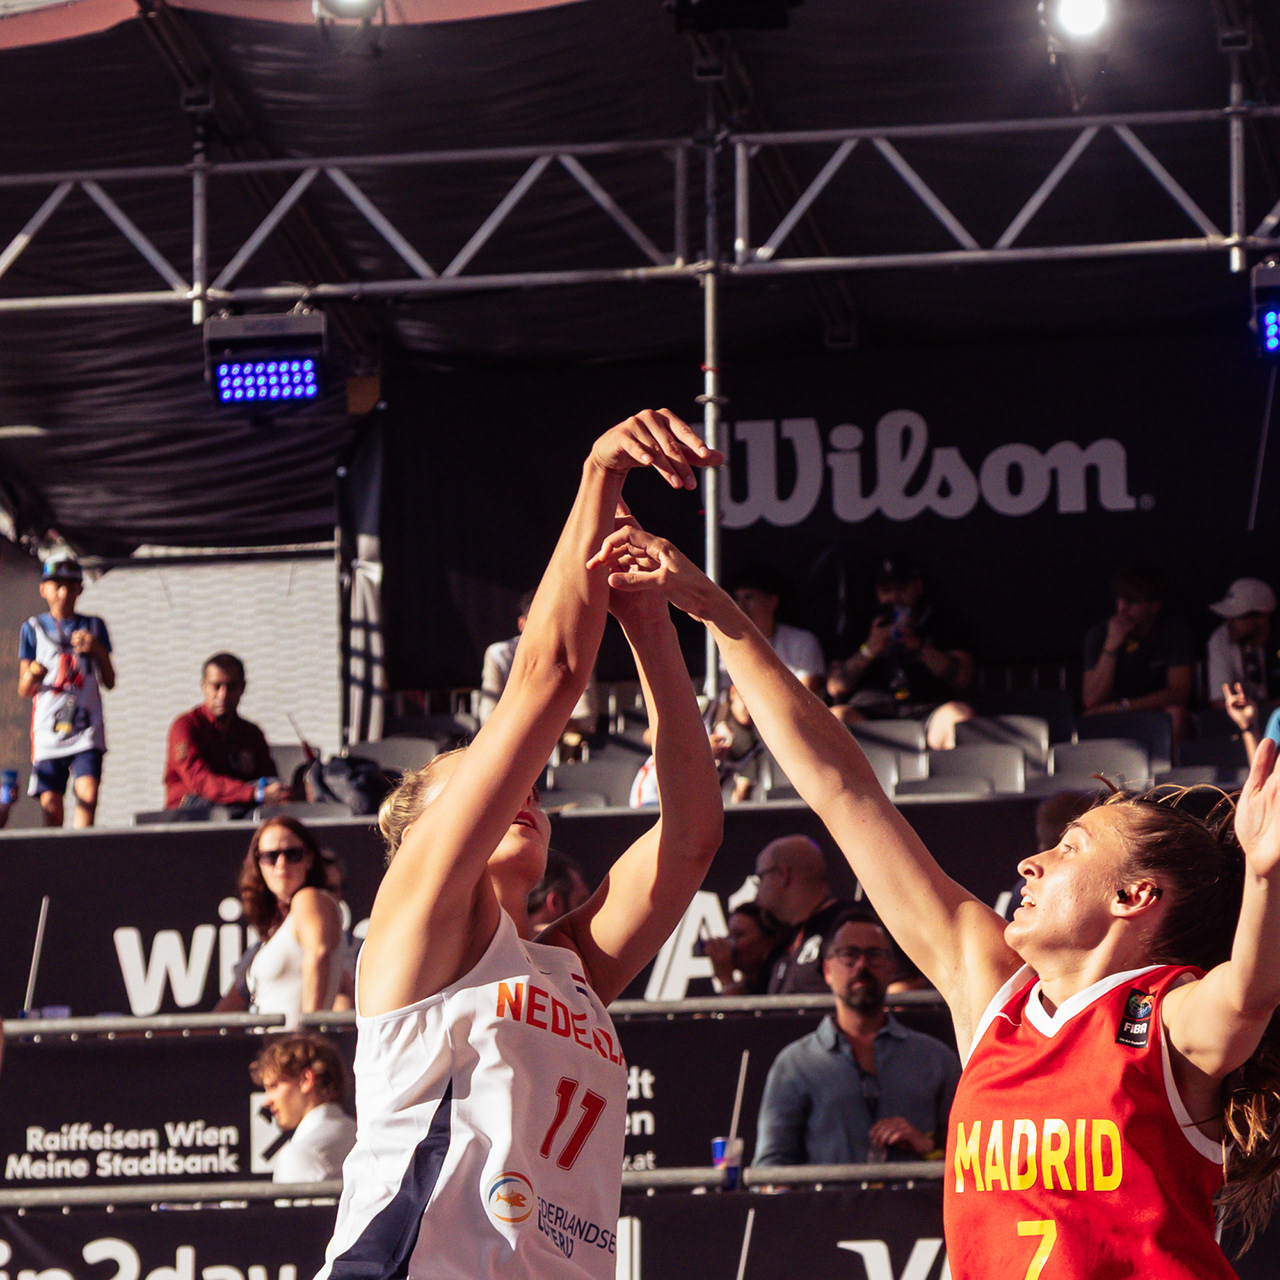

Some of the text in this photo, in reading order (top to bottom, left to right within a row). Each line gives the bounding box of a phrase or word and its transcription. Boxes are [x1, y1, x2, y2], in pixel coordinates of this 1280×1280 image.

[688, 409, 1137, 530] Wilson
[1123, 1021, 1148, 1034] FIBA
[26, 1120, 239, 1152] Raiffeisen Wien
[4, 1147, 239, 1181] Meine Stadtbank
[955, 1118, 1124, 1193] MADRID
